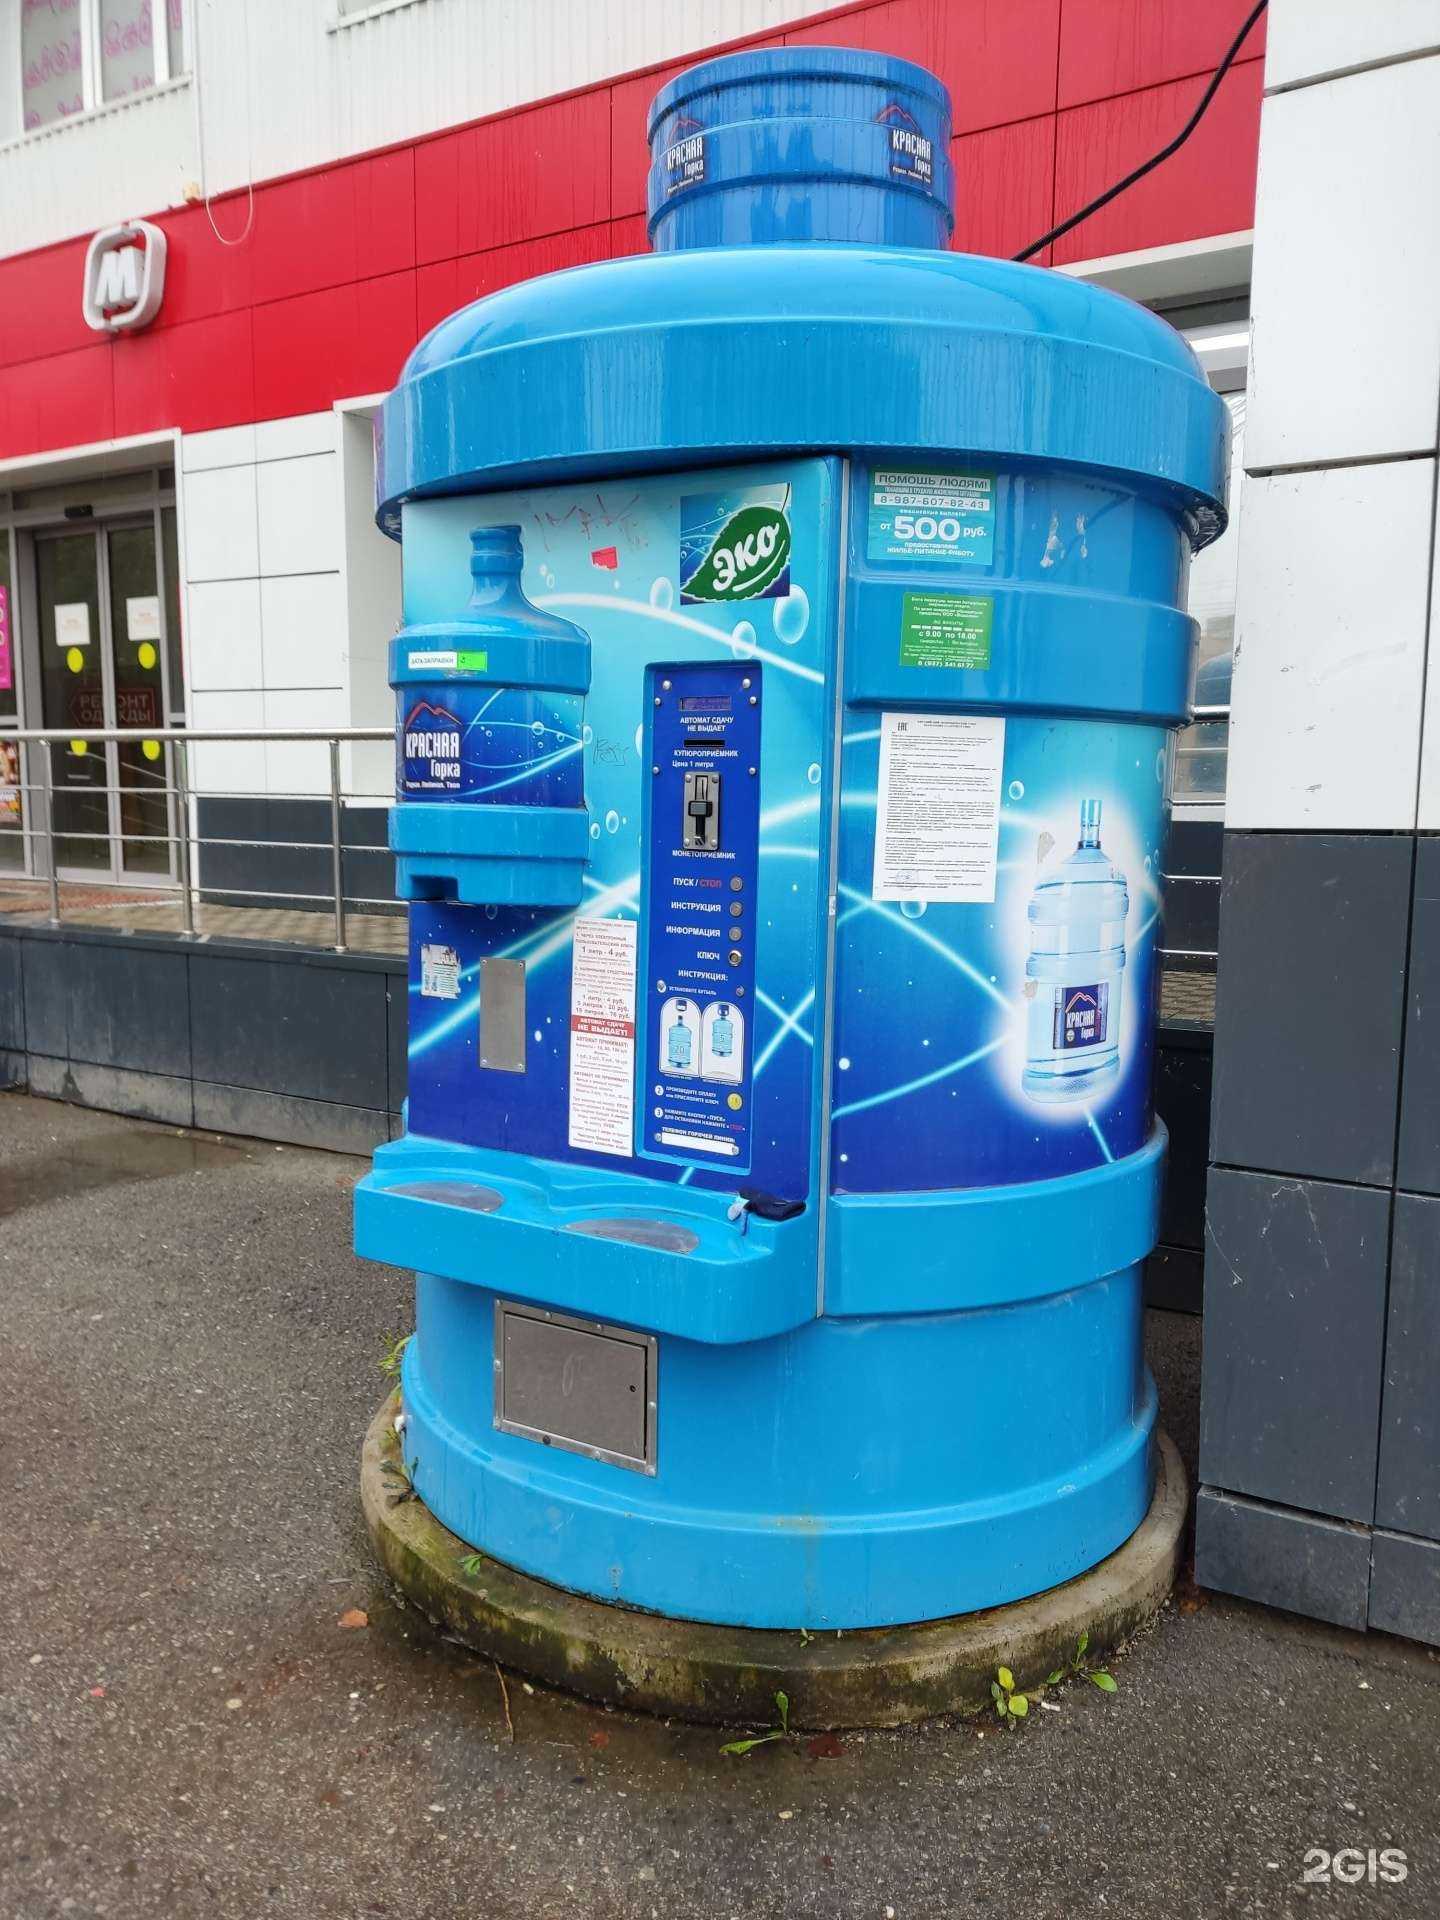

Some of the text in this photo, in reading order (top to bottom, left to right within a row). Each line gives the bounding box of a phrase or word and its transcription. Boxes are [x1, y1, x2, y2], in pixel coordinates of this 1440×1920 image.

[893, 129, 931, 161] КРАСНАЯ
[667, 136, 703, 172] КРАСНАЯ
[879, 474, 988, 489] ПОМОЩЬ ЛЮДЯМ!
[880, 515, 987, 541] от 500 руб.
[925, 630, 942, 638] 9.00
[957, 632, 977, 641] 18.00
[80, 694, 149, 708] РЕОНТ
[680, 716, 734, 725] АВТОМАТ СДАЧУ
[687, 724, 727, 733] НЕ ВЫДАЕТ
[405, 731, 460, 759] КРАСНАЯ
[430, 758, 461, 780] Горка
[672, 760, 688, 769] Цена
[694, 761, 714, 769] литра
[673, 877, 694, 887] ПУСК
[699, 878, 722, 888] СТОП
[671, 901, 721, 913] ИНСТРУКЦИЯ
[665, 925, 721, 938] ИНФОРМАЦИЯ
[696, 951, 720, 961] КЛЮЧ
[678, 969, 729, 981] ИНСТРУКЦИЯ:
[1066, 1009, 1095, 1029] КРАСНАЯ
